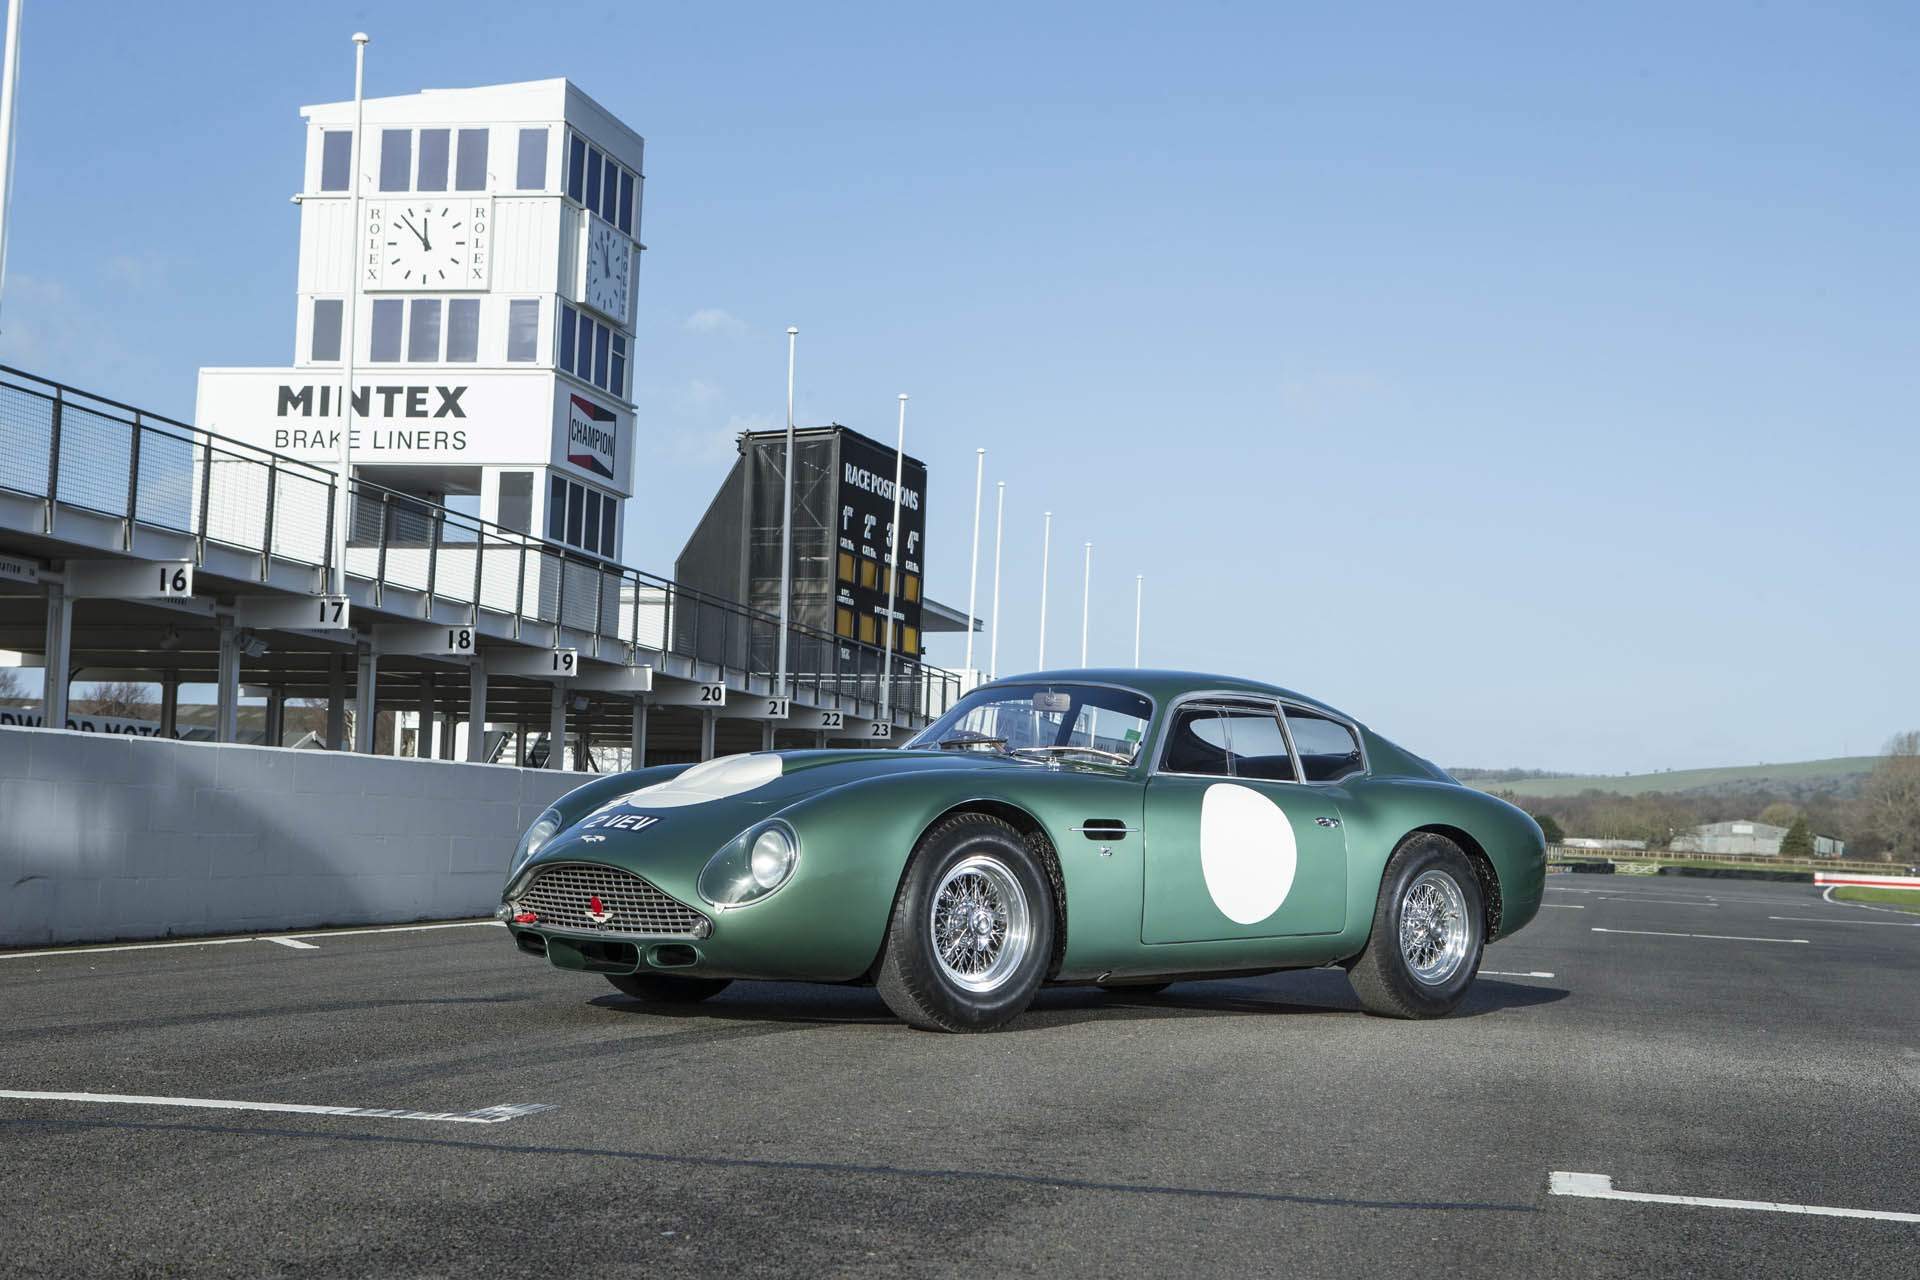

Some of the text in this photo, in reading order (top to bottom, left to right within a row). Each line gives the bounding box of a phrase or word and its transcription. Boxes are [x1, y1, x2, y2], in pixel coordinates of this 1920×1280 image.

[367, 208, 381, 280] ROLEX
[472, 207, 486, 280] ROLEX
[277, 385, 468, 418] MINTEX
[274, 429, 467, 450] BRAKE LINERS
[571, 418, 614, 457] CHAMPION
[845, 462, 919, 510] RACE POSITONS
[160, 568, 187, 592] 16
[320, 601, 344, 623] 17
[448, 630, 471, 649] 18
[553, 653, 573, 671] 19
[701, 686, 722, 702] 20
[768, 701, 785, 715] 21
[822, 712, 841, 726] 22
[871, 723, 889, 737] 23
[583, 814, 659, 831] 2 VEV
